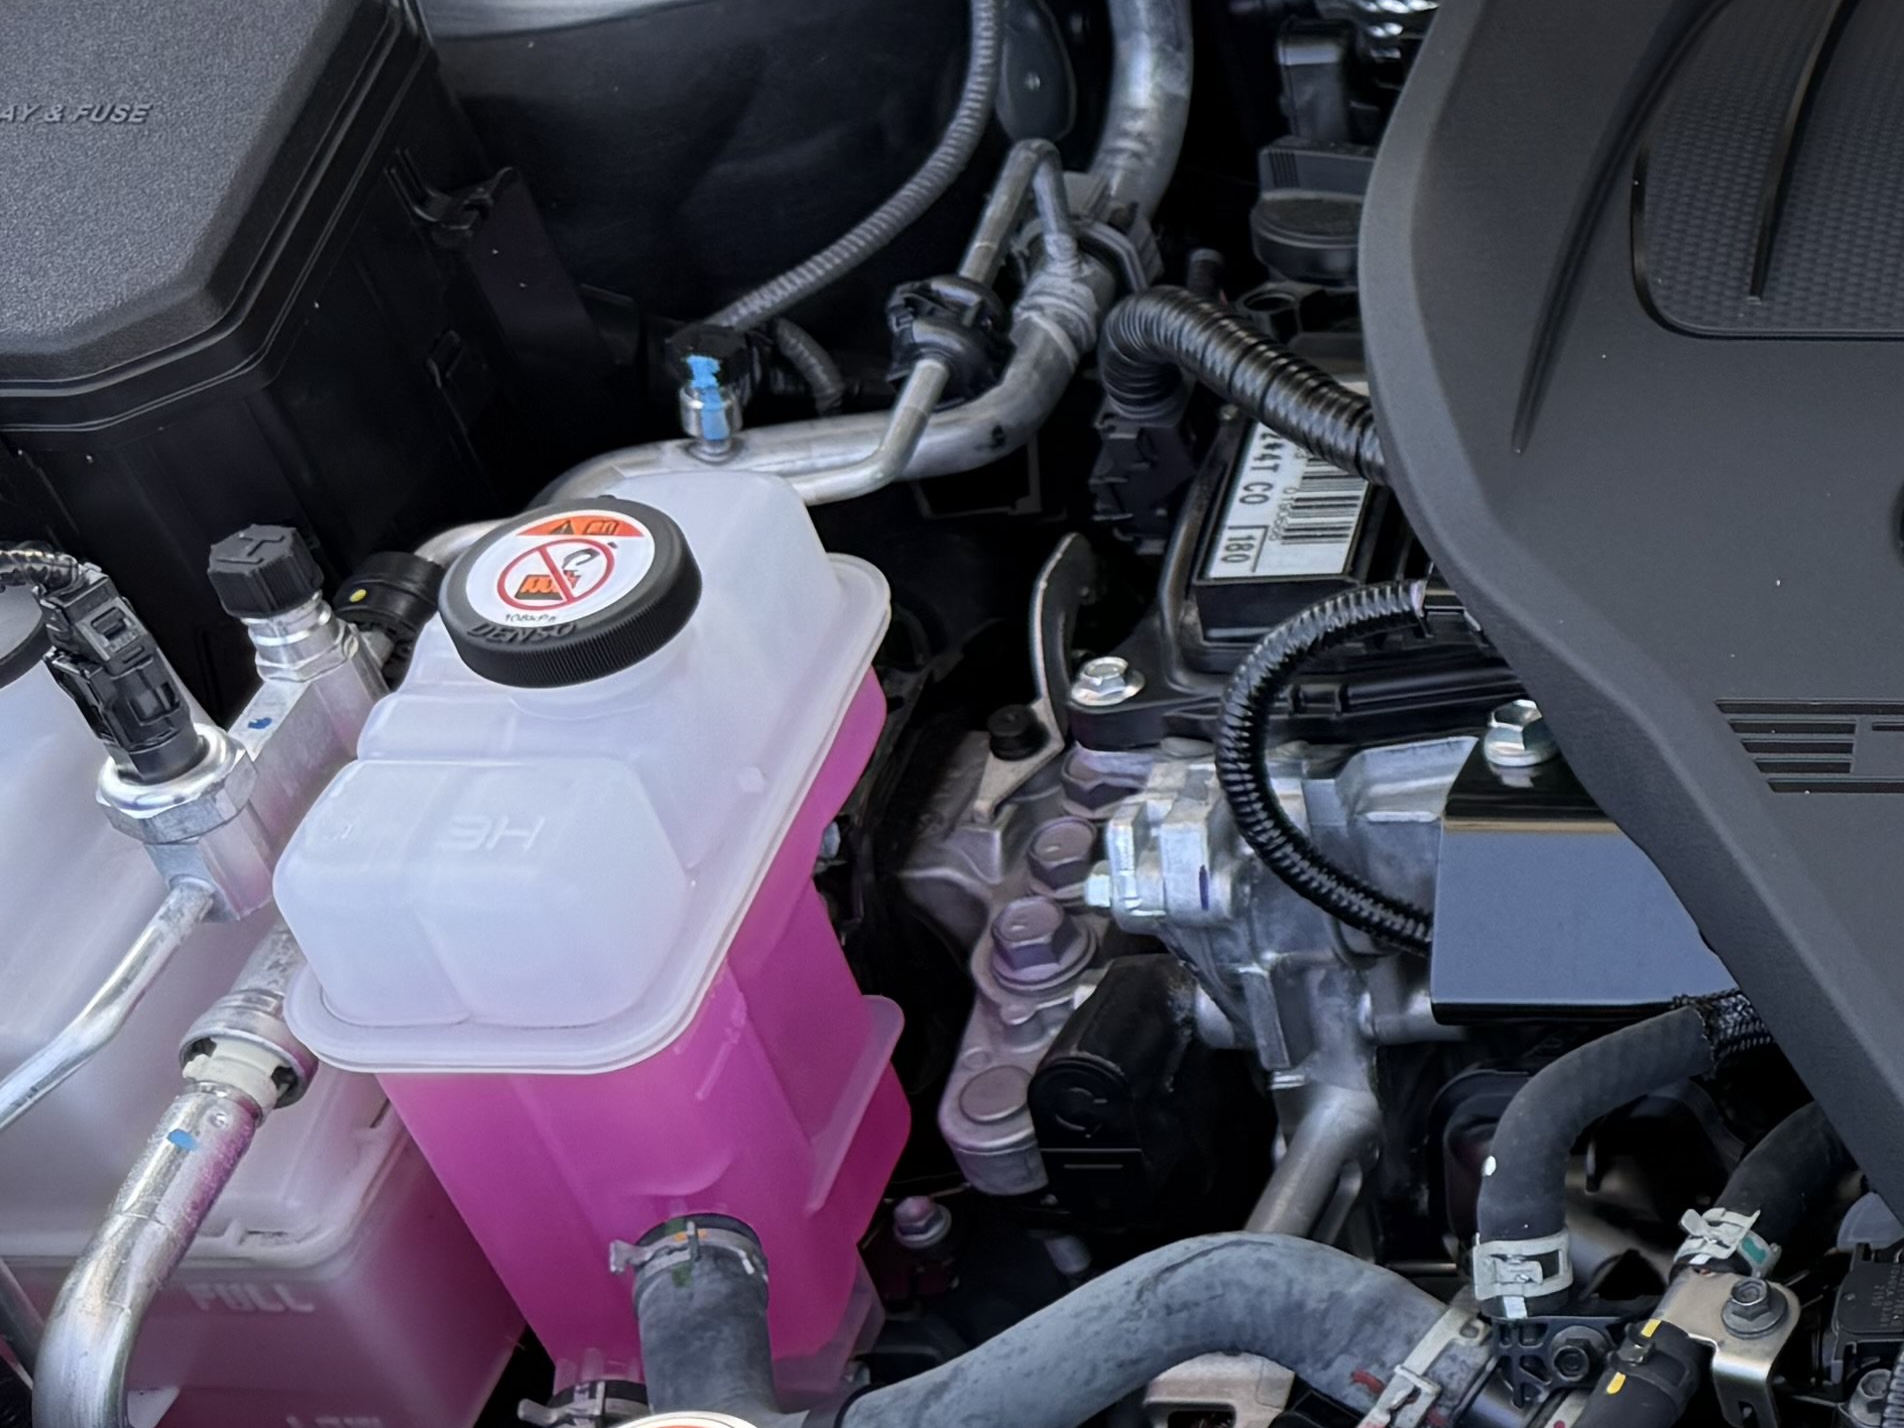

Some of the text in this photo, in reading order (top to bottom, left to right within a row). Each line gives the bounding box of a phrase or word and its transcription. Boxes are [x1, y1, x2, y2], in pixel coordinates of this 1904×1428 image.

[44, 103, 65, 123] &
[72, 103, 153, 124] FUSE
[1220, 534, 1257, 564] 180
[467, 623, 577, 644] DENSO
[185, 1283, 315, 1312] FULL
